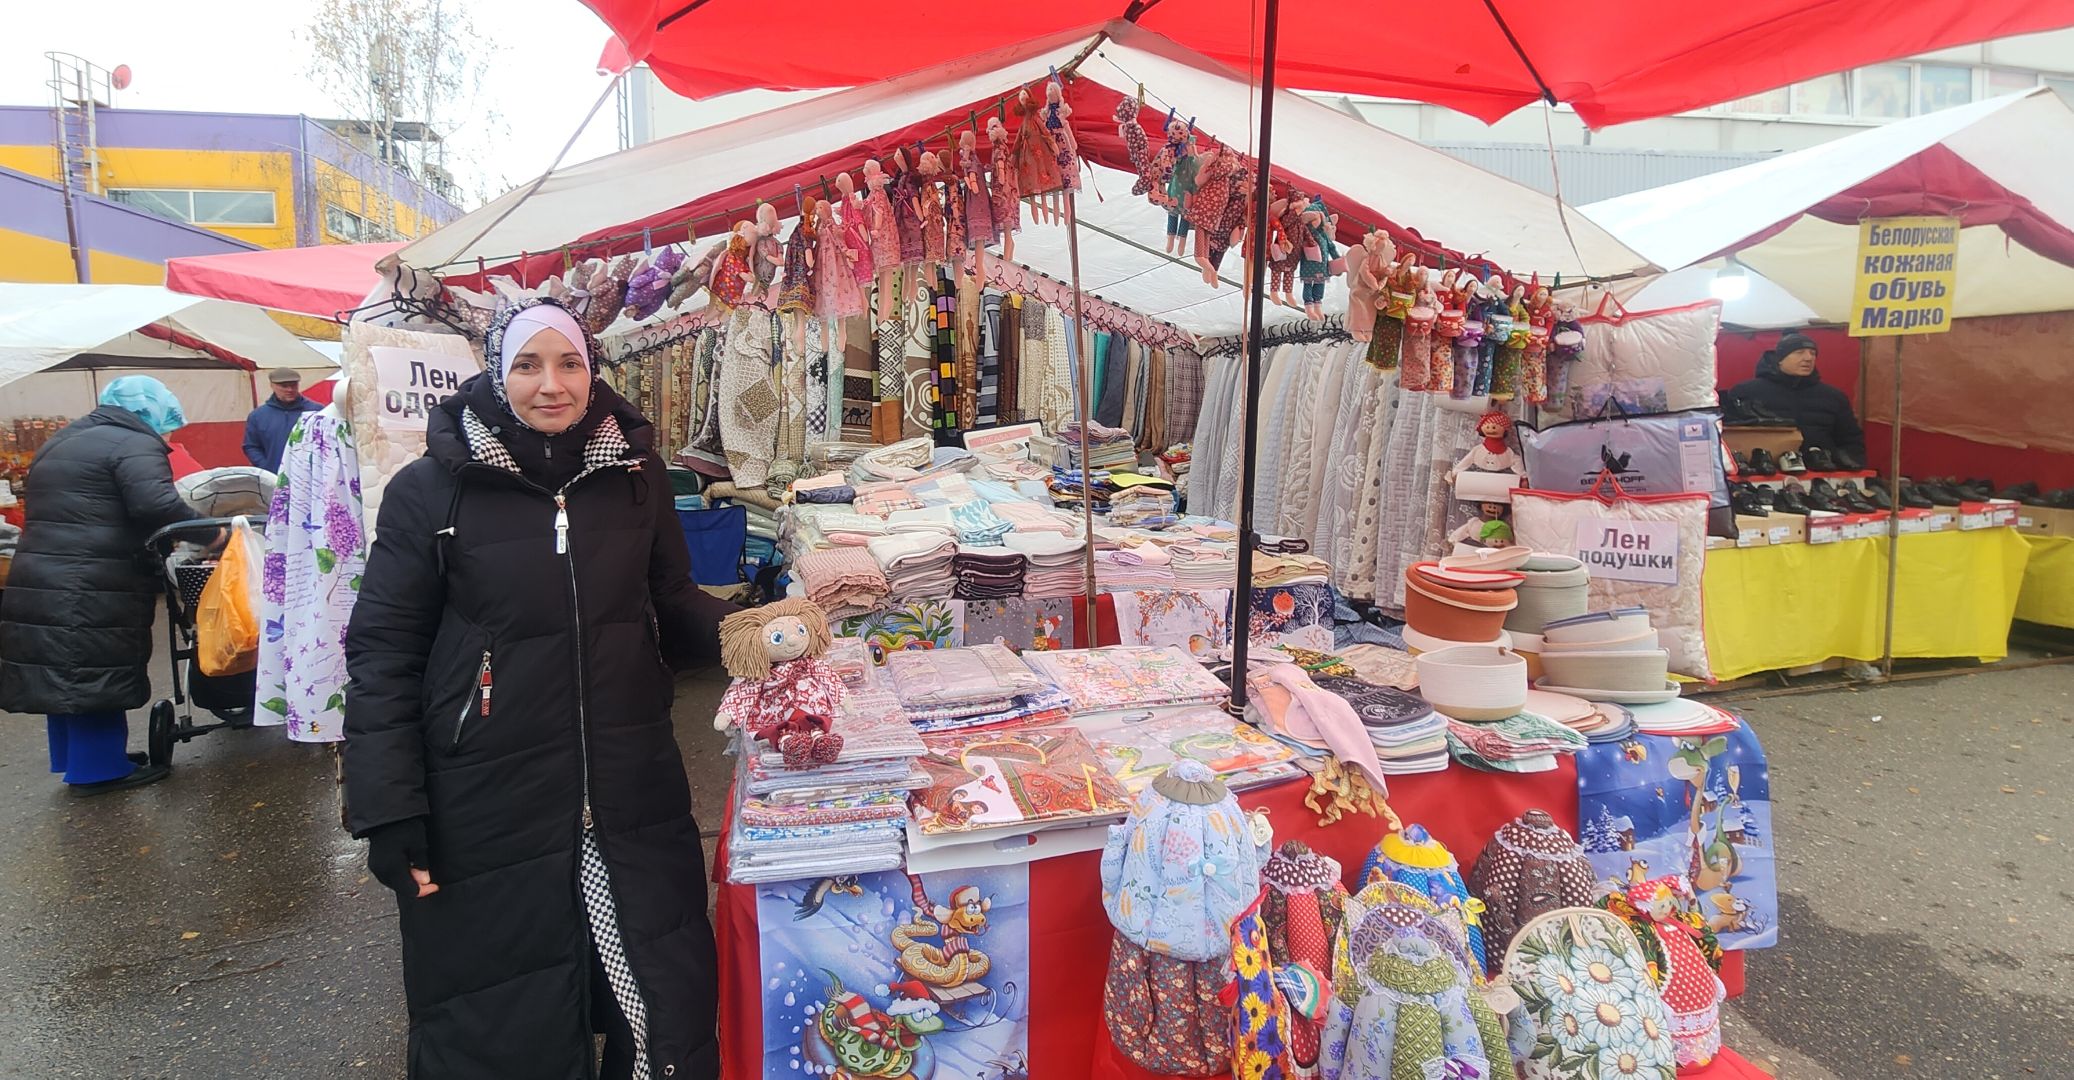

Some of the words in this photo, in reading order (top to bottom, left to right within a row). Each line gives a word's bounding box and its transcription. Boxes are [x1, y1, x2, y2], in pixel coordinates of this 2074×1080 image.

[1869, 224, 1955, 247] Белорусская
[1864, 253, 1953, 274] кожаная
[1869, 277, 1946, 302] обувь
[1861, 307, 1944, 329] Марко
[410, 361, 459, 390] Лен
[385, 390, 449, 418] оде
[1600, 528, 1650, 550] Лен
[1579, 550, 1673, 570] подушки
